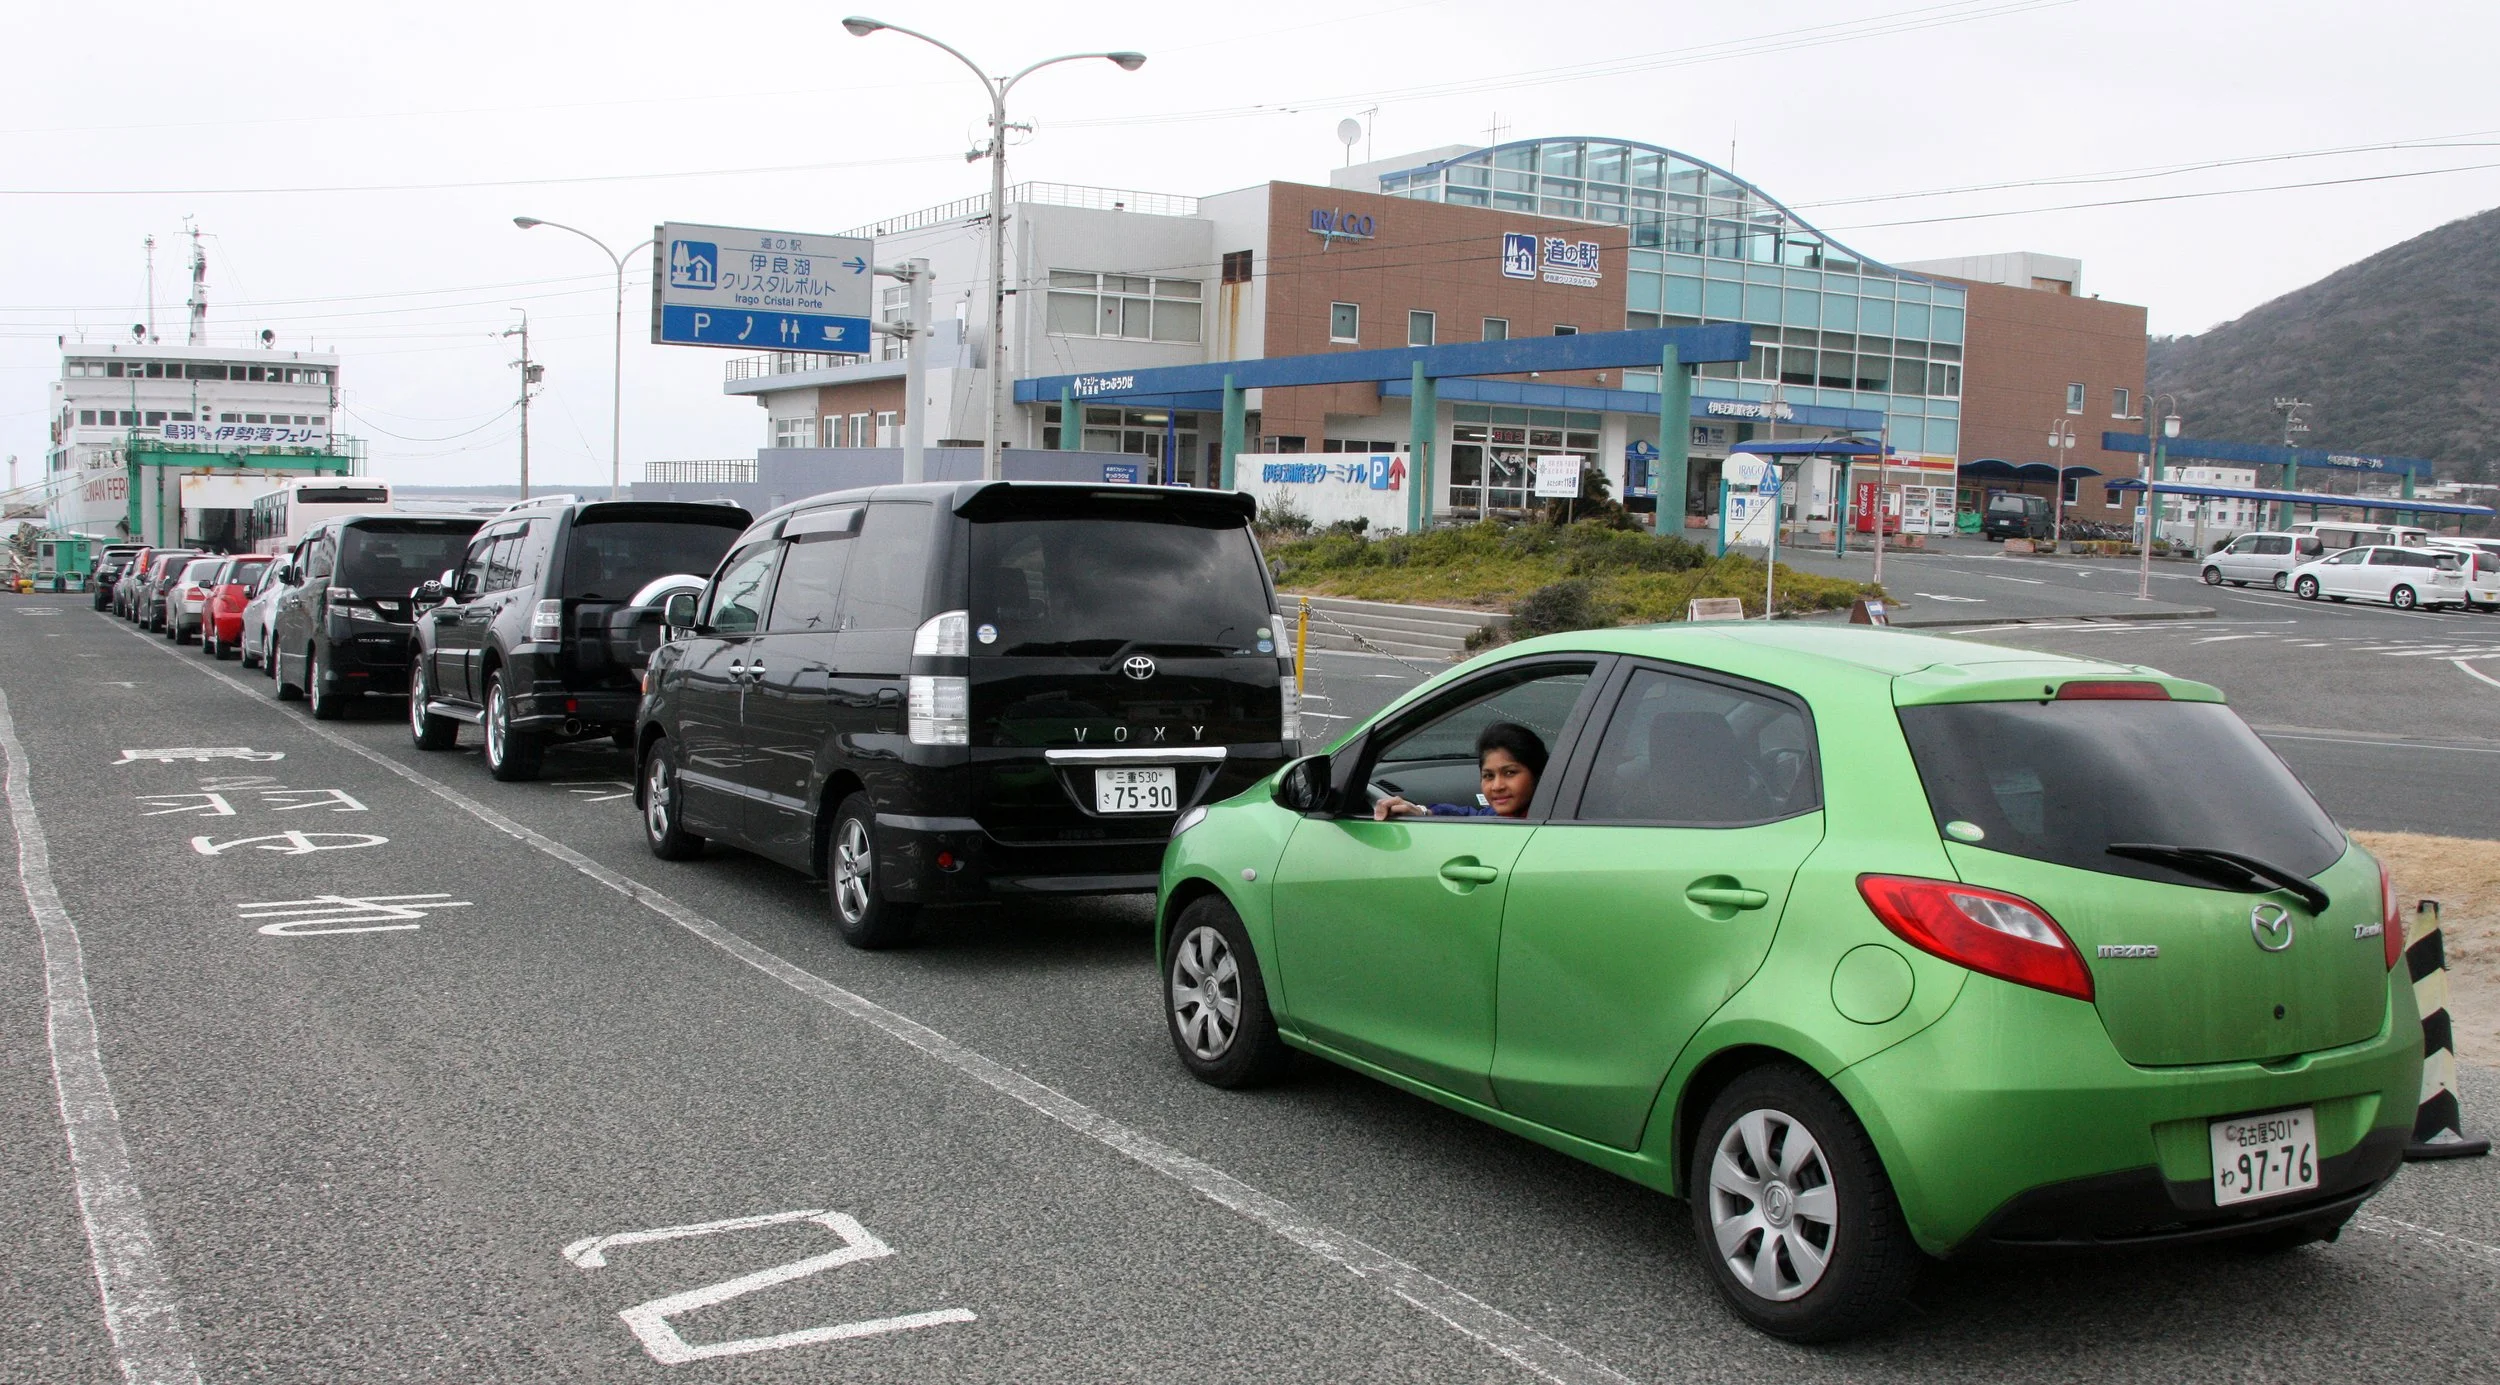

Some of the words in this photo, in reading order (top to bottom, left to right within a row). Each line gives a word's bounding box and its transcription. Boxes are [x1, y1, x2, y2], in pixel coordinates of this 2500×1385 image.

[761, 238, 802, 251] 道の駅
[1544, 238, 1600, 271] 道の駅
[750, 254, 811, 276] 伊良湖
[722, 273, 836, 297] クリスタルポルト
[735, 293, 760, 306] Irago
[764, 295, 794, 307] Cristal
[798, 298, 823, 309] Porte
[694, 313, 711, 337] P
[1708, 402, 1794, 420] 伊良湖旅客タル
[215, 426, 323, 443] 伊勢湾フェリー
[1372, 461, 1384, 485] P
[1739, 464, 1764, 475] IRAGO
[1073, 726, 1204, 743] VOXY
[1116, 771, 1158, 784] 三重530
[1114, 785, 1173, 809] 75-90
[2097, 944, 2160, 959] mazda
[2236, 1119, 2292, 1148] 名古屋501
[2220, 1167, 2235, 1188] わ
[2237, 1142, 2313, 1195] 97-76
[562, 1208, 985, 1366] 2
